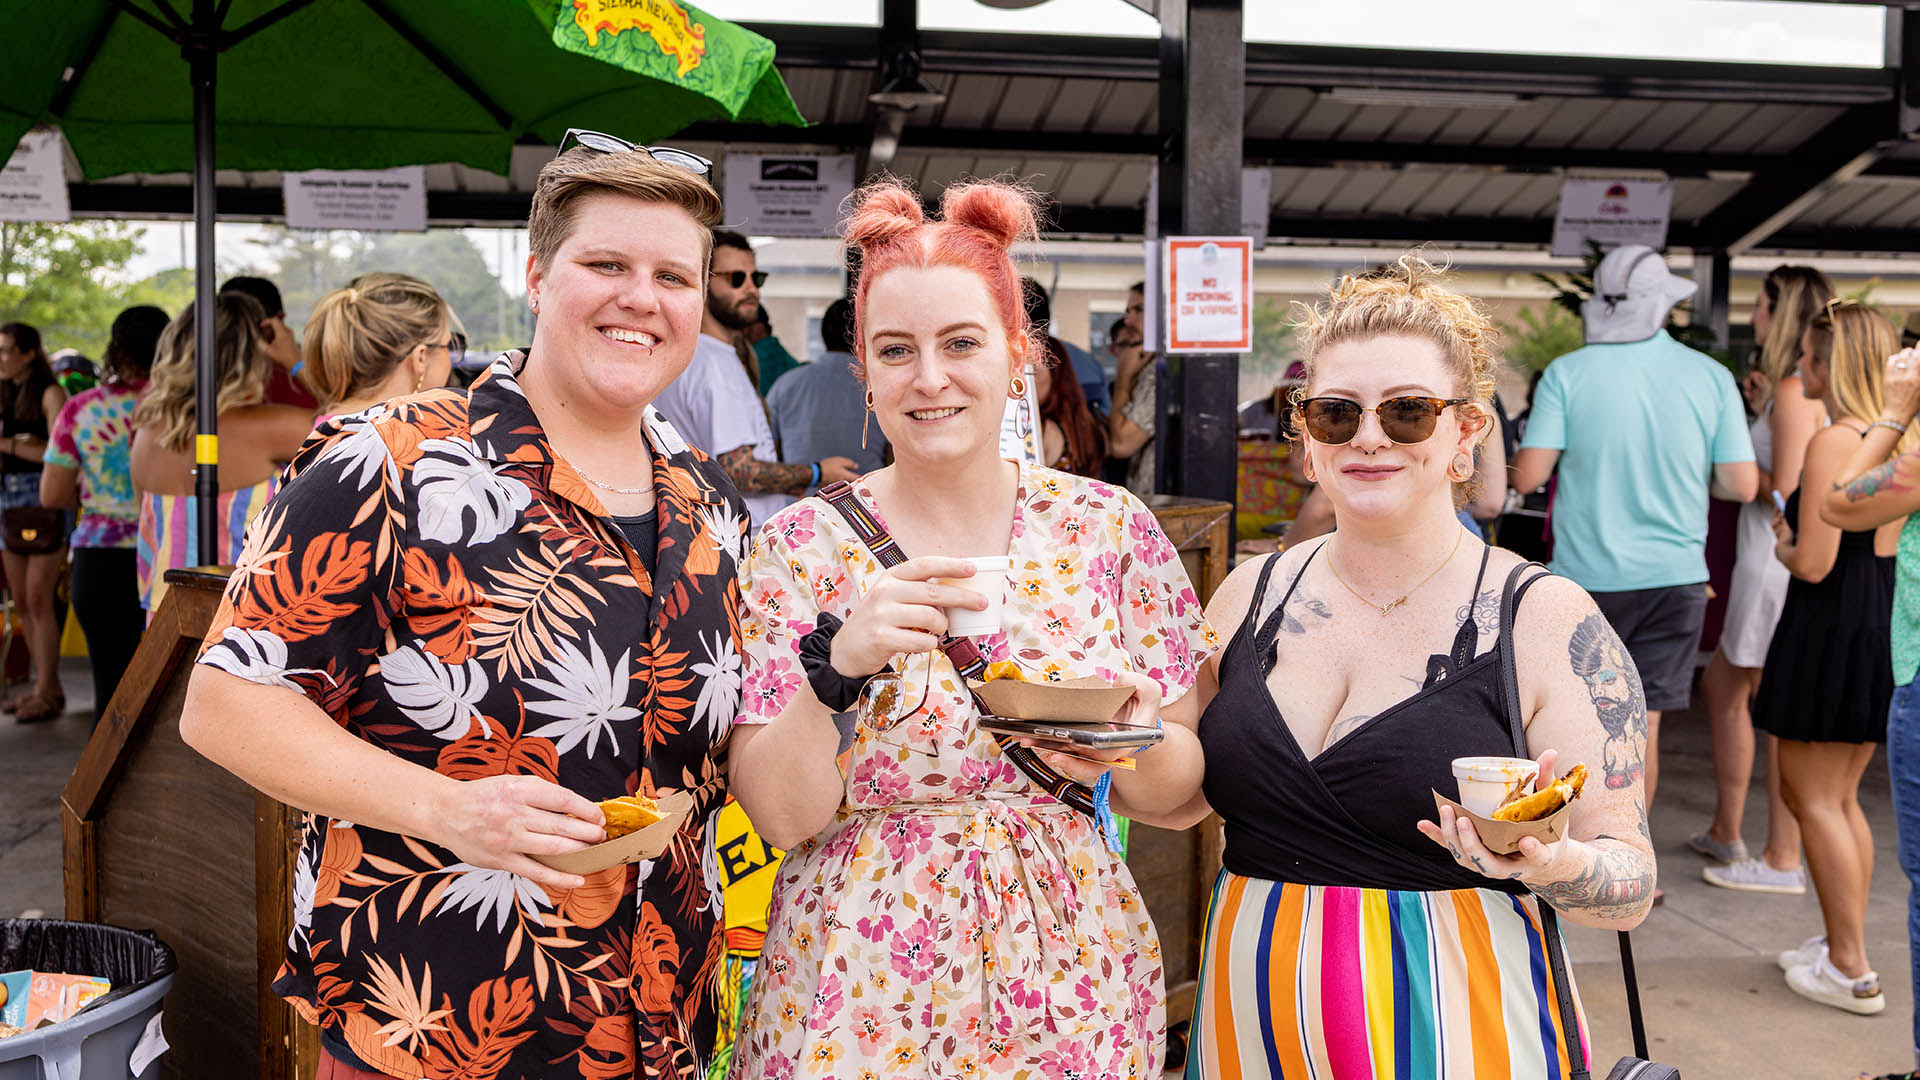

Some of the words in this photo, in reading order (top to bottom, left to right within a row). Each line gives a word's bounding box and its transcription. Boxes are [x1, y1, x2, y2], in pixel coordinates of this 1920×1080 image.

[1202, 277, 1217, 288] NO
[1186, 291, 1232, 302] SMOKING
[1199, 304, 1238, 315] VAPING
